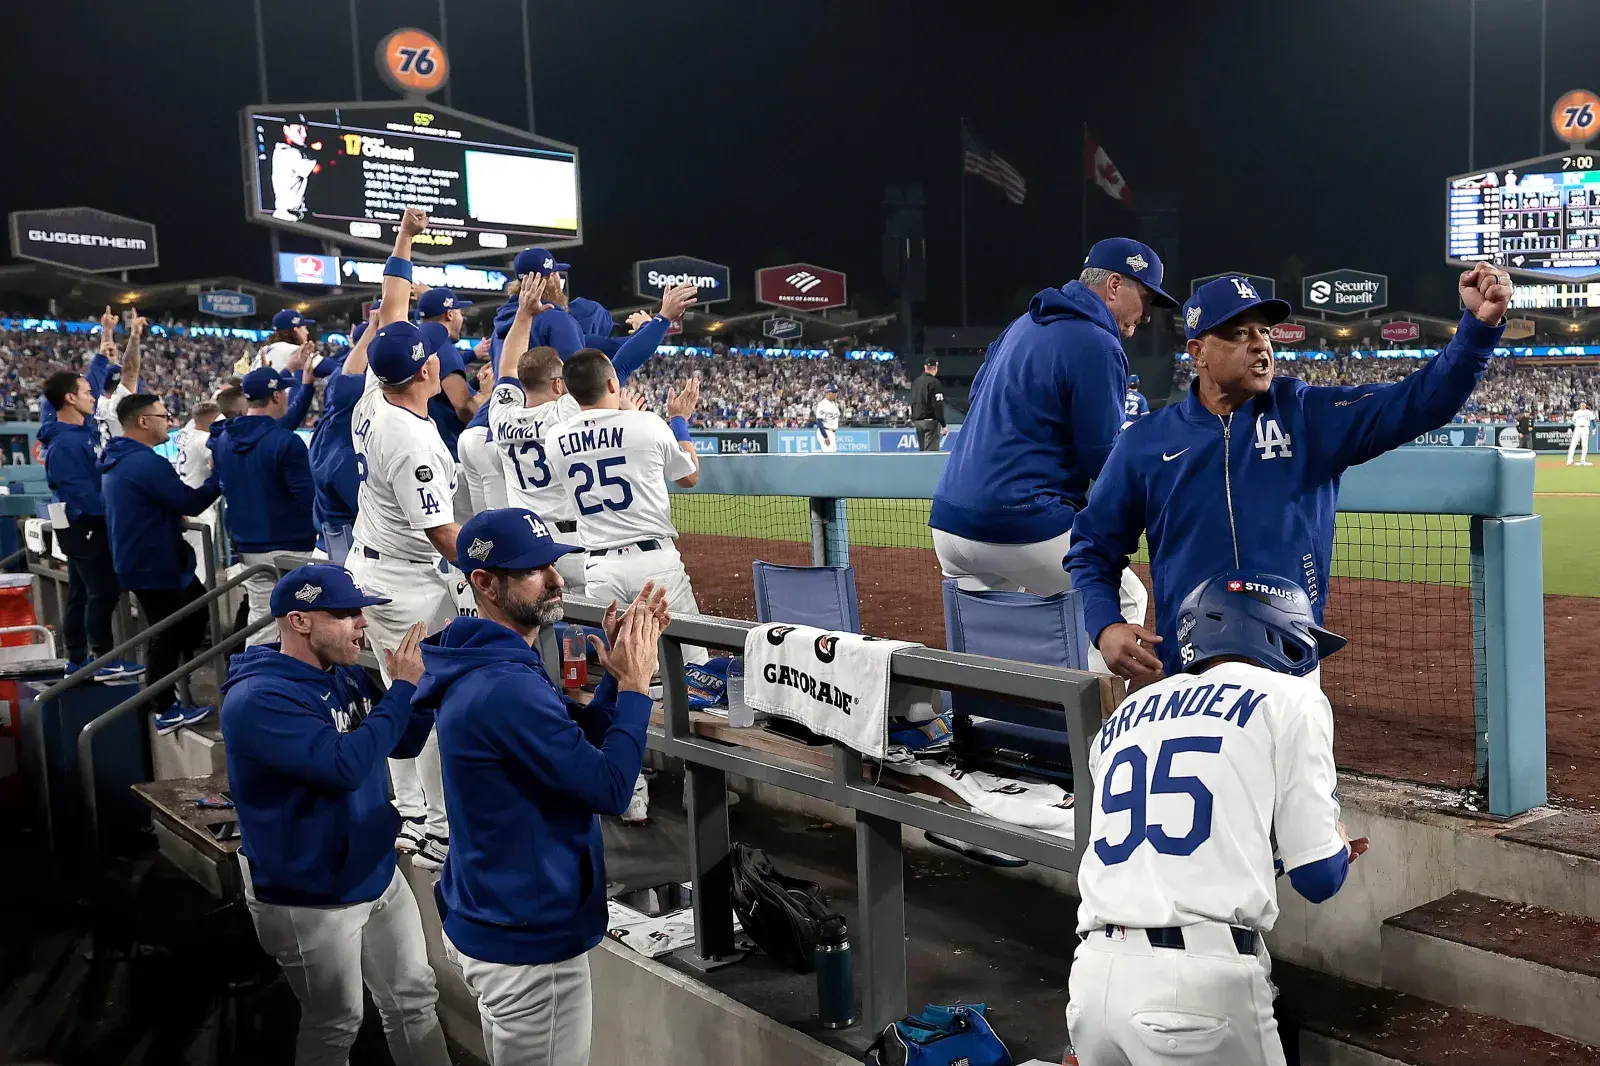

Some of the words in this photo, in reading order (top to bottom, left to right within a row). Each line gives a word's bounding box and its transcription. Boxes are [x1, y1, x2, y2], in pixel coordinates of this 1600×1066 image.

[397, 47, 436, 77] 76
[1563, 103, 1594, 128] 76
[1562, 156, 1593, 170] 7:00
[28, 230, 146, 250] GUGGENHEIM
[648, 270, 715, 289] Spectrum
[1230, 278, 1256, 299] LA
[1334, 280, 1379, 293] Security
[1335, 292, 1373, 304] Benefit
[1270, 327, 1303, 338] Churu
[498, 420, 544, 441] MUNCY
[558, 427, 624, 457] EDMAN
[1255, 412, 1292, 459] LA
[508, 440, 551, 490] 13
[568, 455, 634, 516] 25
[417, 488, 440, 515] LA
[523, 514, 549, 538] LA
[1302, 553, 1317, 605] DODGERS
[1245, 582, 1299, 603] STRAUSS
[1180, 642, 1195, 665] 95
[1100, 683, 1267, 755] BRANDEN
[1094, 736, 1223, 866] 95
